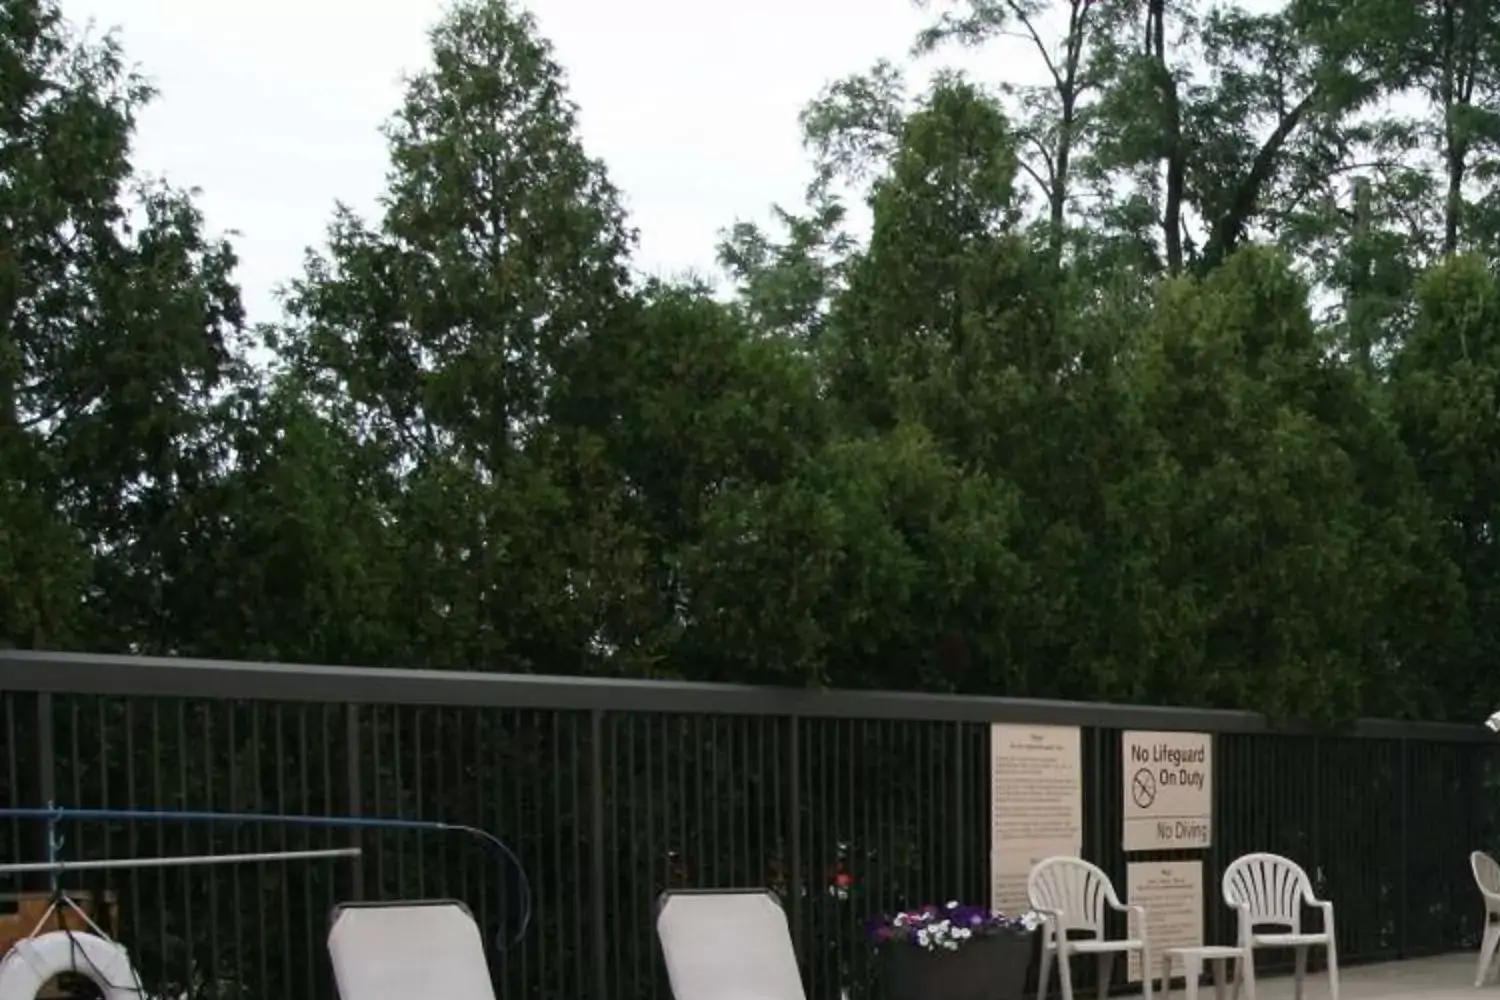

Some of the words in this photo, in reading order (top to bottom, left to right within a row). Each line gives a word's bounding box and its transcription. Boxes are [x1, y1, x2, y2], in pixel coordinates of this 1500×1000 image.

[1131, 743, 1149, 763] No
[1153, 743, 1204, 767] Lifeguard
[1160, 768, 1177, 786] On
[1180, 768, 1204, 792] Duty
[1157, 821, 1173, 840] No
[1175, 821, 1207, 843] Diving
